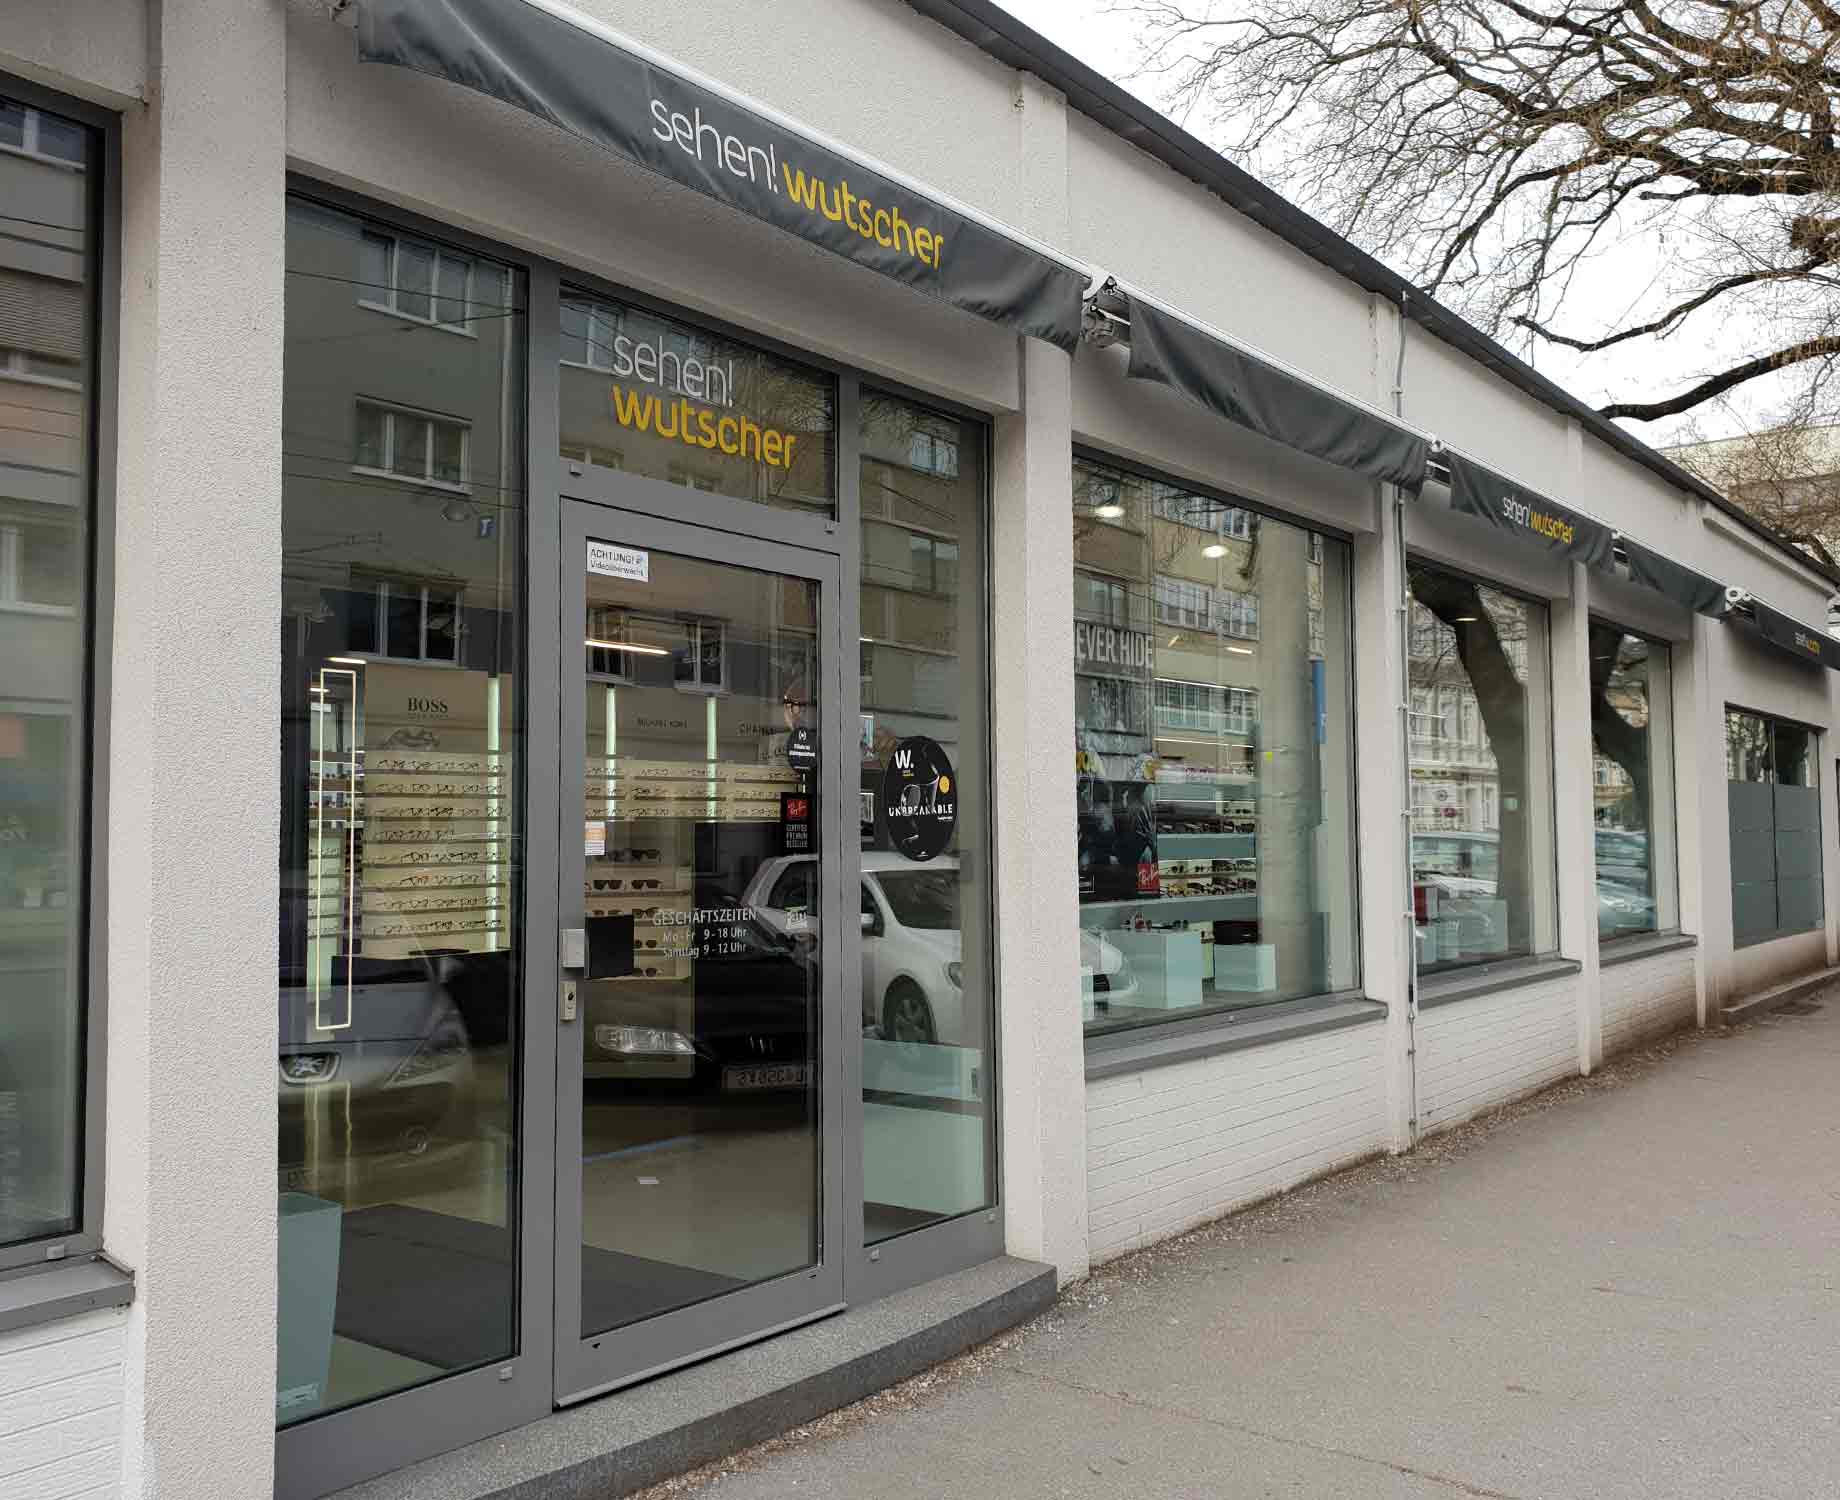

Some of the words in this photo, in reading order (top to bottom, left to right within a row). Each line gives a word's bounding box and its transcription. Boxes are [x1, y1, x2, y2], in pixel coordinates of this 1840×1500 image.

[650, 99, 778, 194] sehen!
[783, 161, 944, 270] wutscher
[613, 335, 733, 408] sehen!
[612, 383, 796, 469] wutscher
[591, 548, 634, 564] ACHTUNG!
[1073, 622, 1119, 663] EVER
[1120, 630, 1153, 668] HIDE
[407, 697, 448, 713] BOSS
[895, 750, 914, 769] W.
[730, 926, 748, 938] Uhr
[730, 941, 748, 953] Uhr
